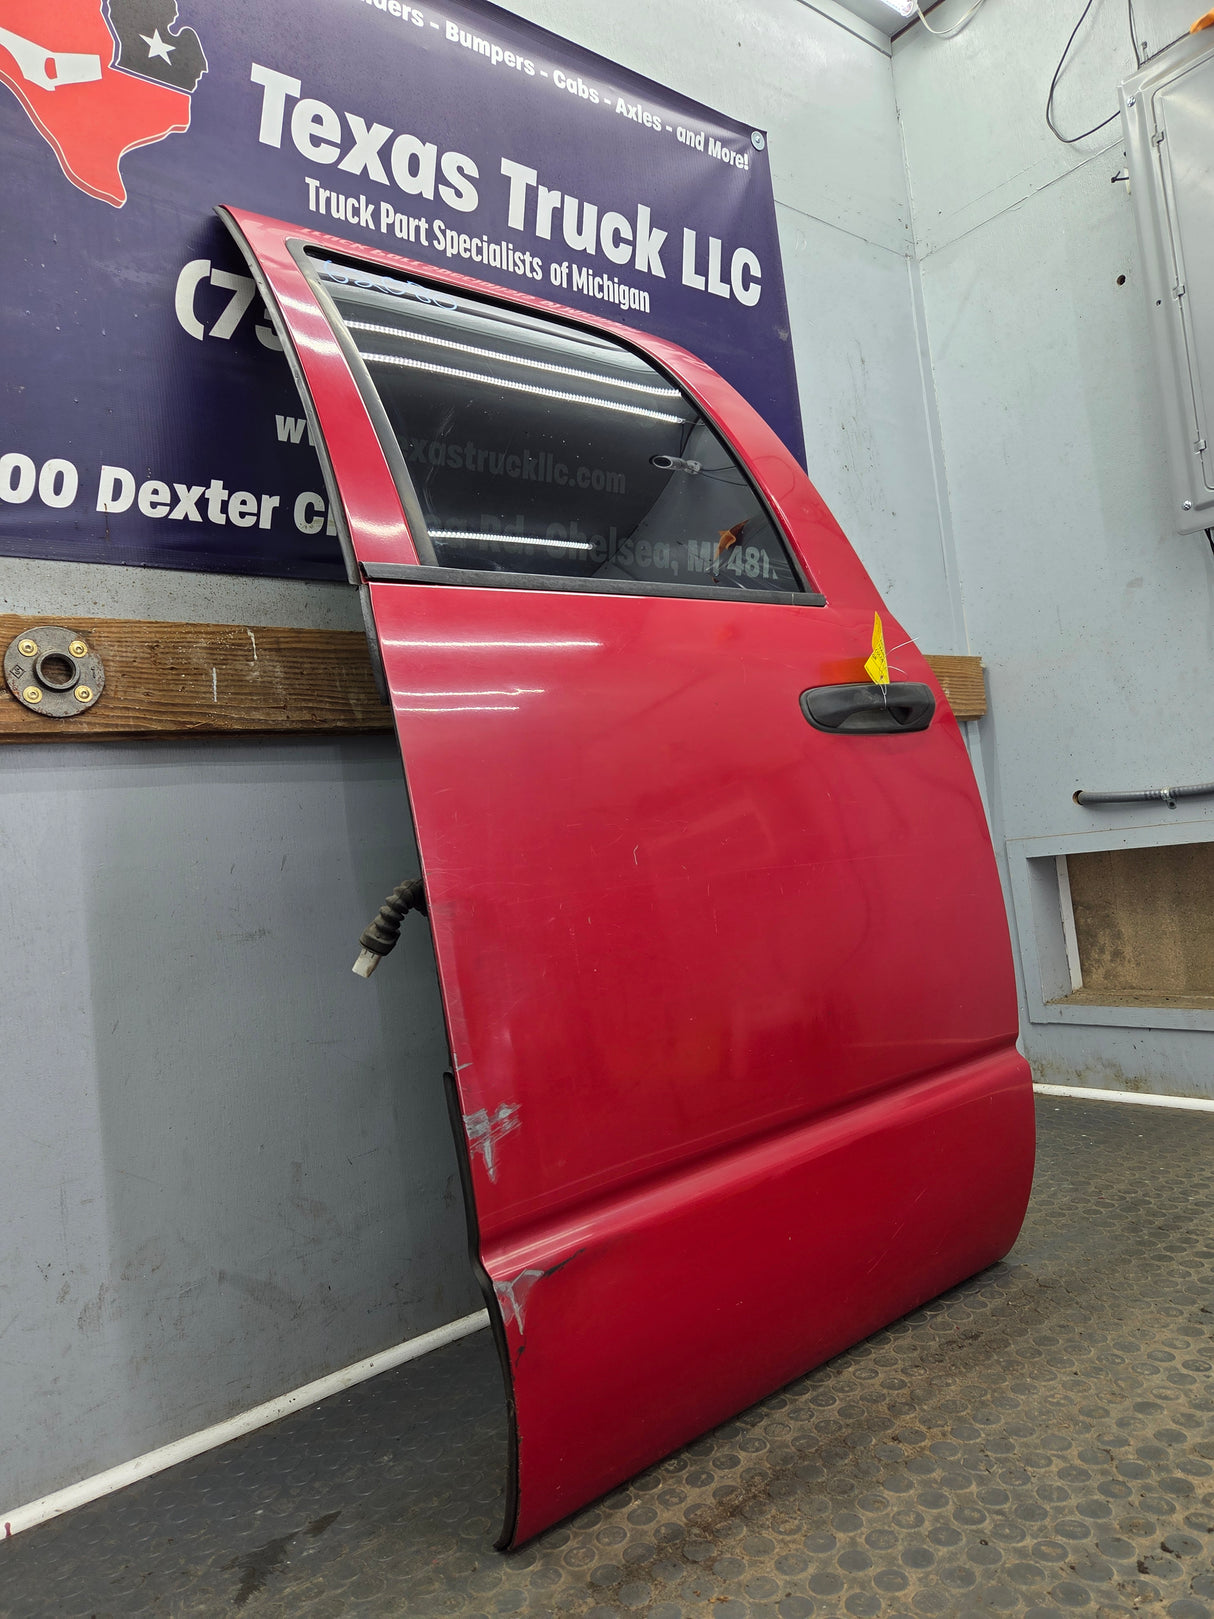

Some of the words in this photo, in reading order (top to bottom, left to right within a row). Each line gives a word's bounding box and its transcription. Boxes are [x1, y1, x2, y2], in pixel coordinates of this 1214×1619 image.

[445, 20, 536, 76] Bumpers
[553, 69, 600, 104] Cabs
[615, 97, 662, 132] Axles
[676, 126, 705, 152] and
[707, 136, 749, 170] More!
[250, 62, 480, 213] Texas
[501, 156, 668, 279] Truck
[682, 227, 762, 307] LLC
[305, 176, 375, 230] Truck
[380, 201, 429, 247] Part
[433, 219, 543, 281] Specialists
[550, 261, 569, 289] of
[572, 263, 650, 314] Michigan
[96, 465, 281, 530] Dexter
[546, 520, 679, 577] Chelsea,
